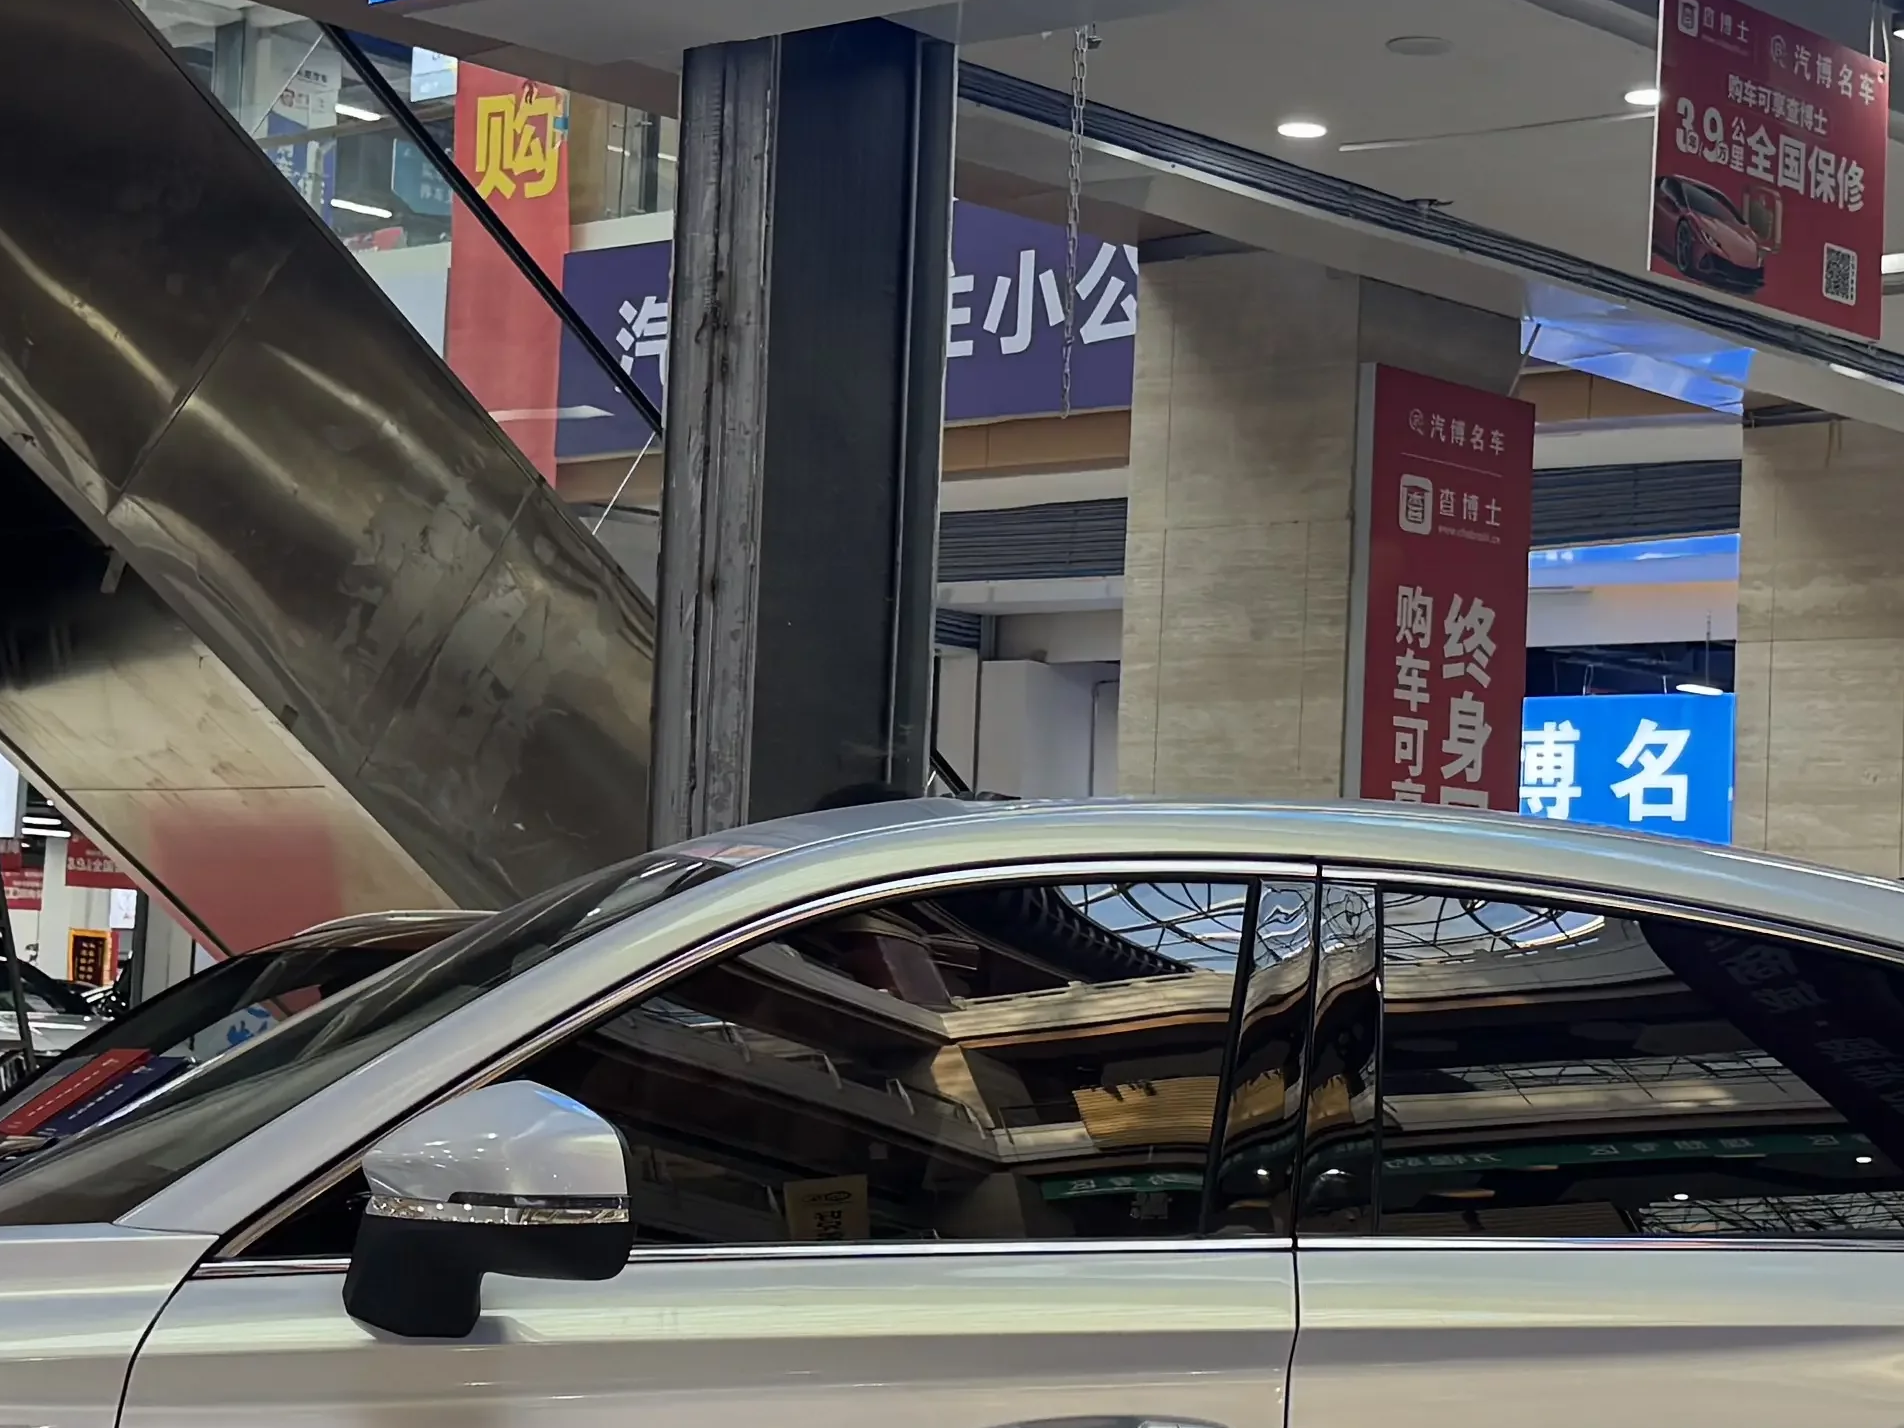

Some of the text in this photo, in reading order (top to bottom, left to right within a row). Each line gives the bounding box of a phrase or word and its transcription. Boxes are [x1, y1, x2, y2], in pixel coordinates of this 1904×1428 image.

[1794, 44, 1875, 106] 汽博名车
[476, 93, 560, 200] 购
[1430, 412, 1505, 456] 汽博名车
[1439, 488, 1502, 527] 查博士
